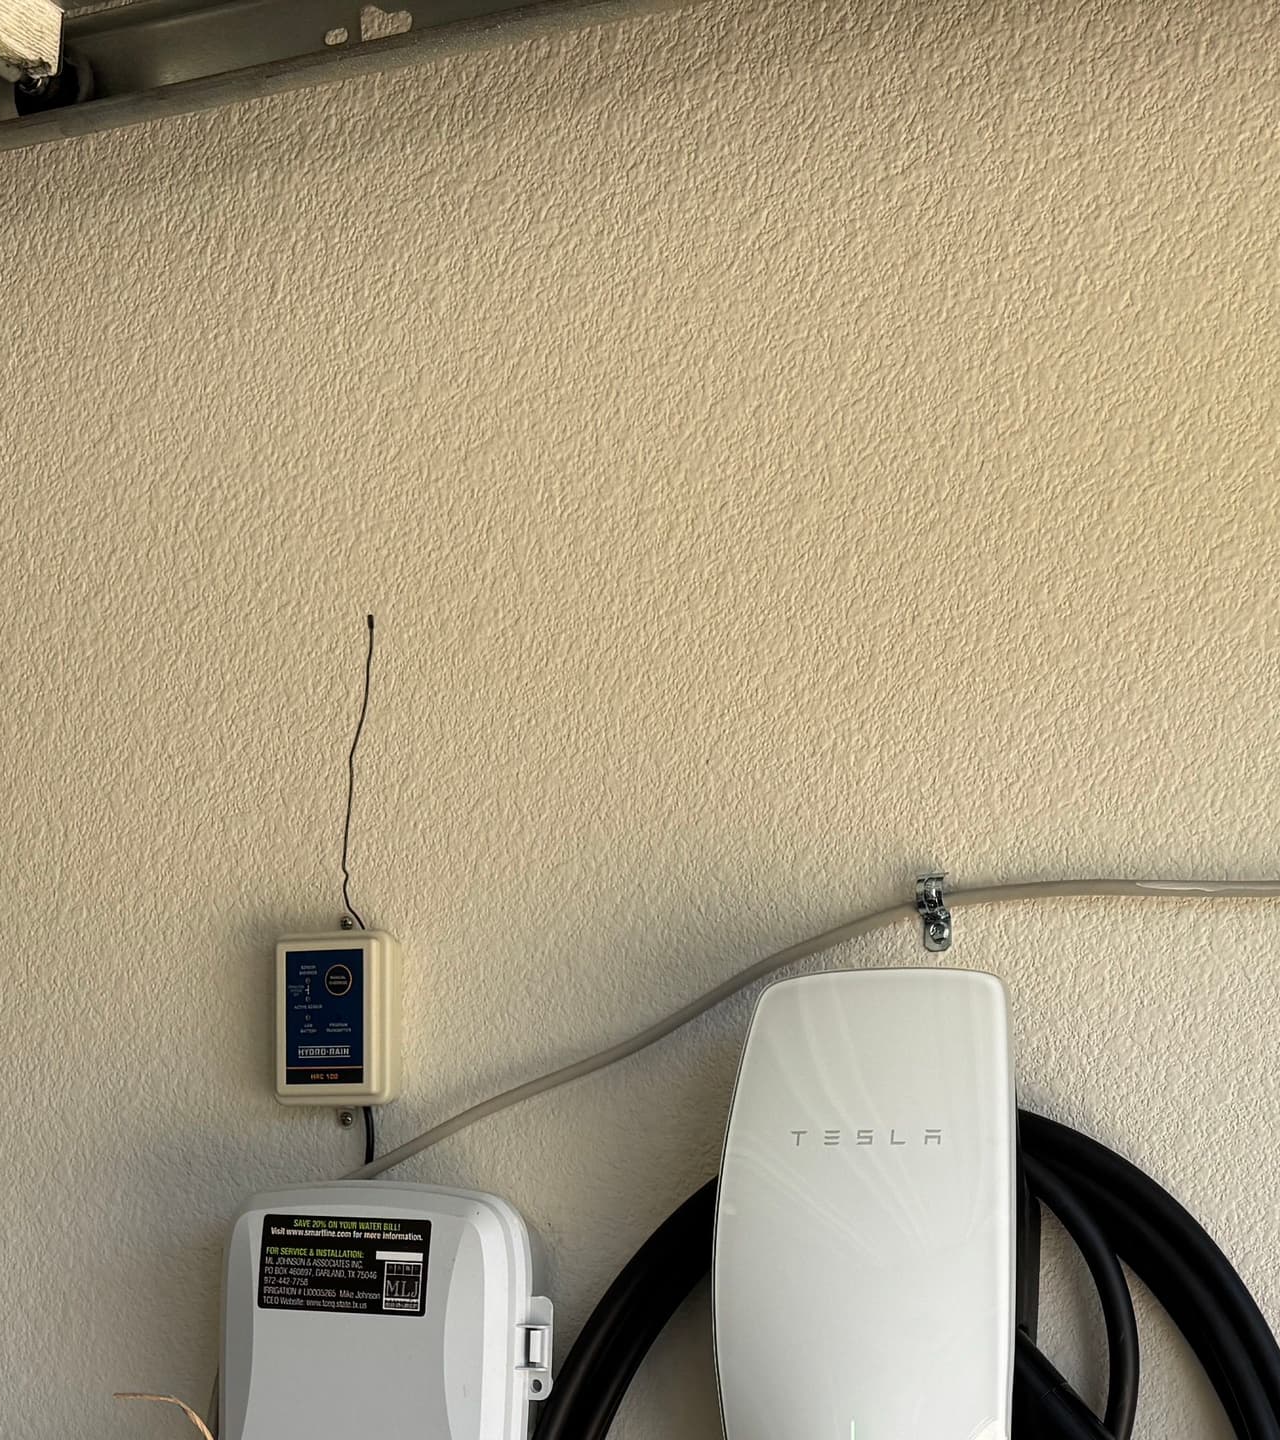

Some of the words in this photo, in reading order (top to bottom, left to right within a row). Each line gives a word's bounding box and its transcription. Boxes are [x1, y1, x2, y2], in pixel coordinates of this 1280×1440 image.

[790, 1128, 942, 1147] TESLA
[294, 1218, 311, 1227] SAVE
[312, 1220, 326, 1228] 20%
[328, 1220, 338, 1228] ON
[340, 1221, 357, 1229] YOUR
[359, 1222, 382, 1230] WATER
[384, 1223, 400, 1231] BILL!
[353, 1230, 362, 1238] for
[382, 1232, 423, 1241] information.
[266, 1246, 279, 1255] FOR
[281, 1247, 308, 1256] SERVICE
[309, 1248, 314, 1256] &
[316, 1248, 364, 1258] INSTALLATION:
[276, 1257, 305, 1266] JOHNSON
[312, 1259, 350, 1268] ASSOCIATES
[265, 1266, 273, 1275] PO
[275, 1267, 288, 1275] BOX
[386, 1280, 419, 1298] MLJ
[355, 1291, 380, 1299] Johnson
